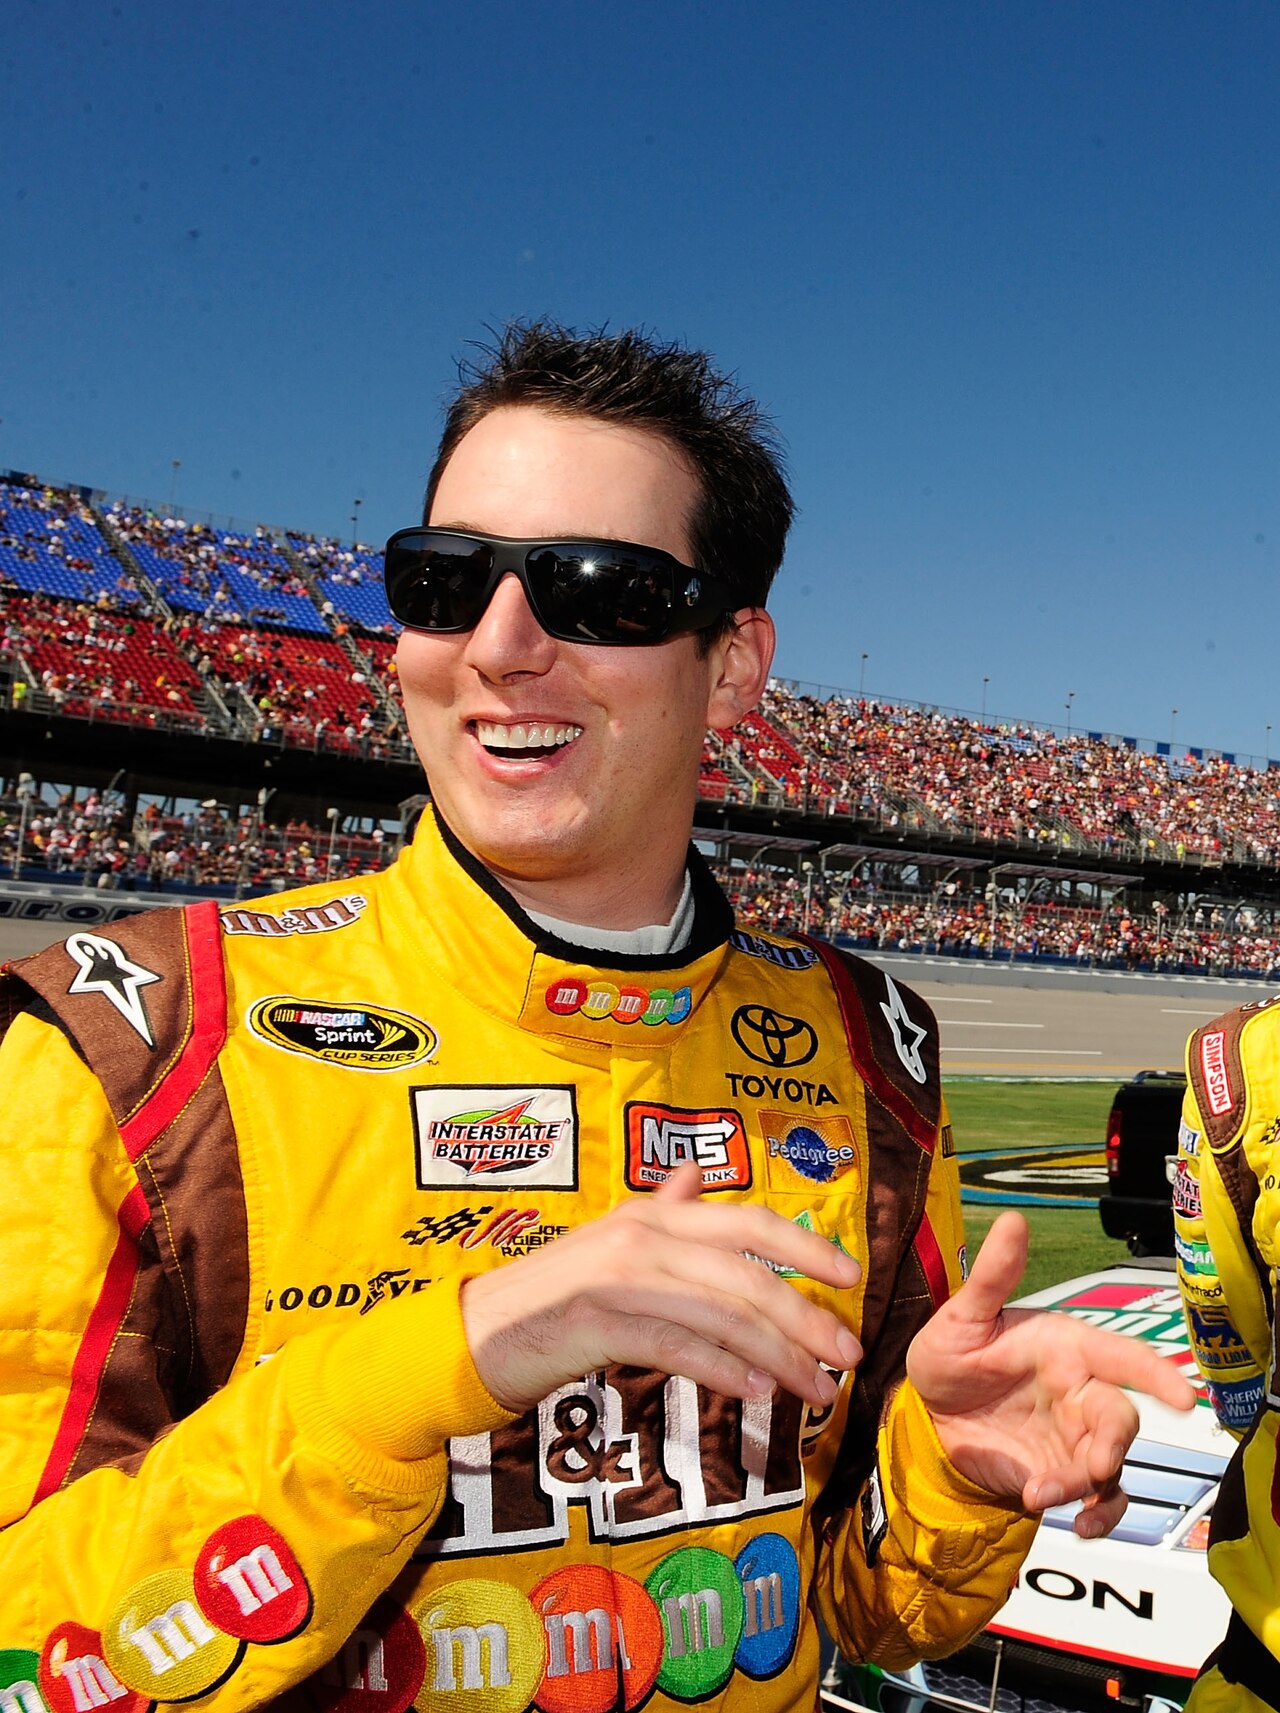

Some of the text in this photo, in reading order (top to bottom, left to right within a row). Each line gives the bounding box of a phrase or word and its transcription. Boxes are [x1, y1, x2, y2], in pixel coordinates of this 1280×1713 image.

[300, 1010, 366, 1026] NASCAR
[315, 1026, 377, 1044] Sprint
[321, 1049, 416, 1063] CUP SERIES
[1205, 1036, 1228, 1108] SIMPSON
[725, 1072, 839, 1107] TOYOTA
[431, 1123, 561, 1141] INTERSTATE
[642, 1116, 730, 1167] NOS
[436, 1143, 552, 1160] BATTERIES
[767, 1136, 854, 1166] Pedigree
[530, 1225, 570, 1236] JOE
[216, 1544, 295, 1617] m
[1016, 1567, 1154, 1620] ON
[128, 1600, 216, 1676] m
[431, 1622, 512, 1691] m
[543, 1608, 632, 1679] m
[662, 1588, 725, 1659] m
[743, 1571, 785, 1637] m
[61, 1653, 129, 1712] m
